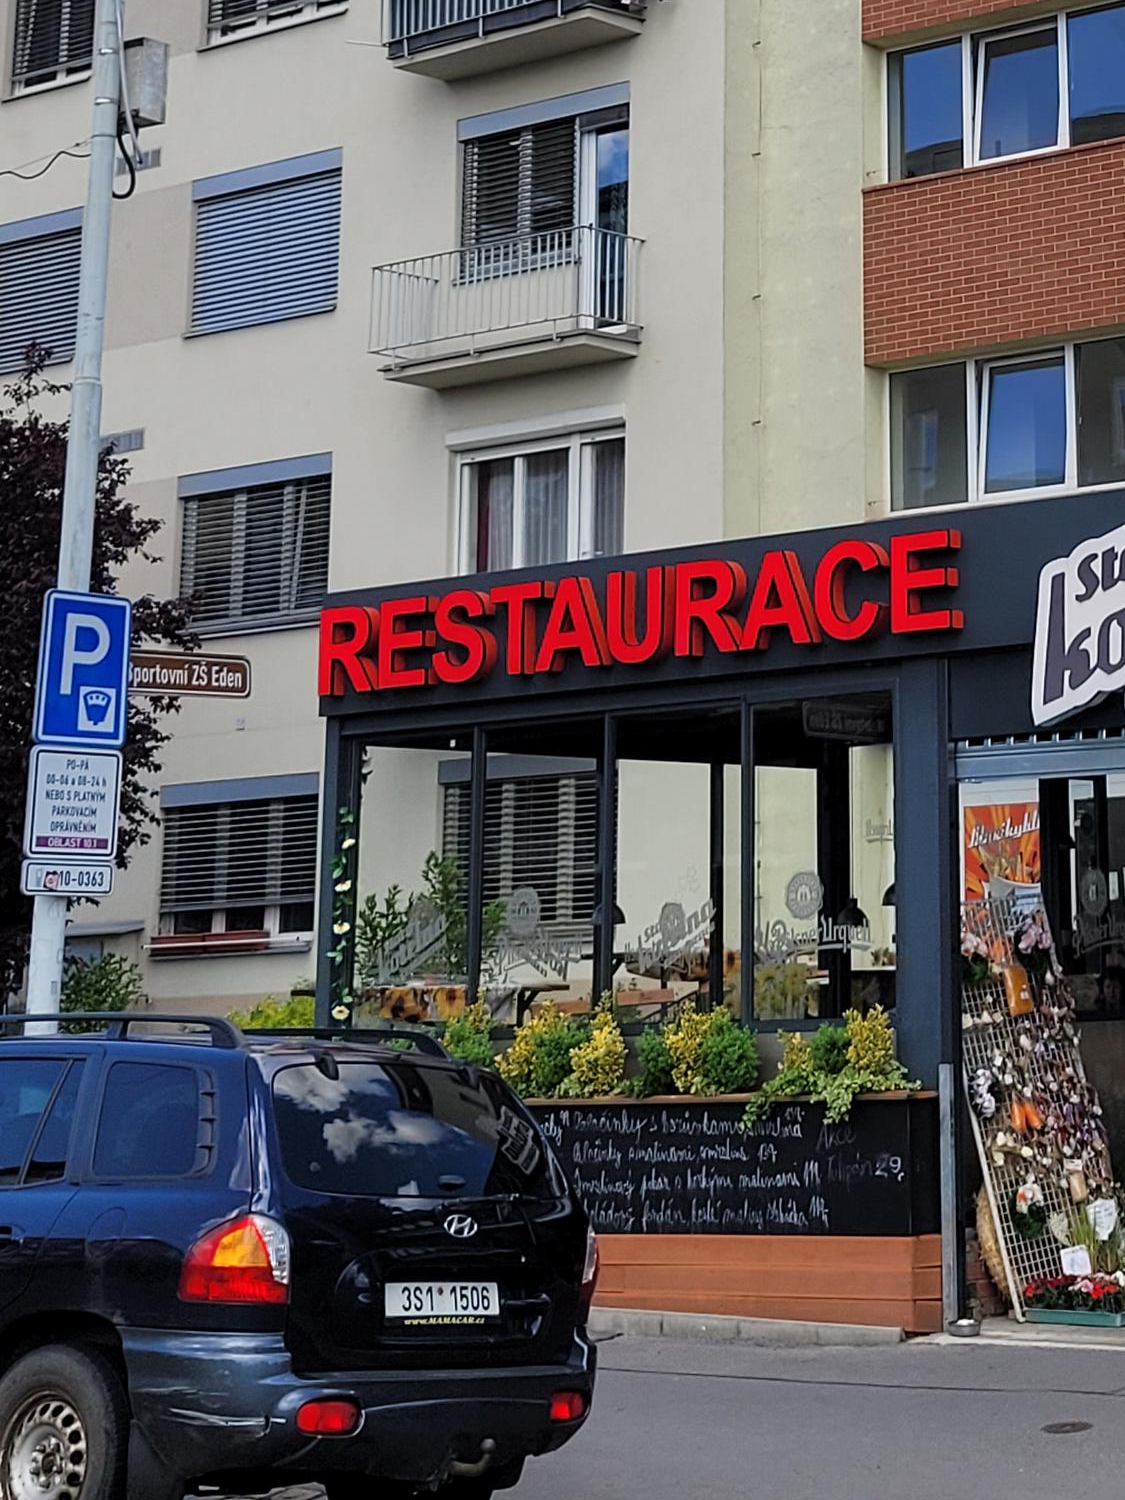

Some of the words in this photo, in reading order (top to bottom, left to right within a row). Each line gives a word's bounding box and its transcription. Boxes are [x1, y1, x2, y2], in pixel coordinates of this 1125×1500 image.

[318, 529, 963, 696] RESTAURACE
[59, 612, 111, 695] P
[192, 661, 208, 686] ZŠ
[211, 667, 242, 688] Eden
[66, 758, 89, 771] PO-PÁ
[45, 789, 65, 801] NEBO
[66, 791, 71, 801] S
[73, 789, 106, 802] PLATNÝM
[51, 805, 97, 818] PARKOVACÍM
[50, 820, 97, 833] OPRÁVNĚNÍM
[47, 837, 82, 848] OBLAST
[44, 870, 104, 887] 10-0363
[401, 1285, 434, 1311] 3S1
[449, 1285, 490, 1311] 1506
